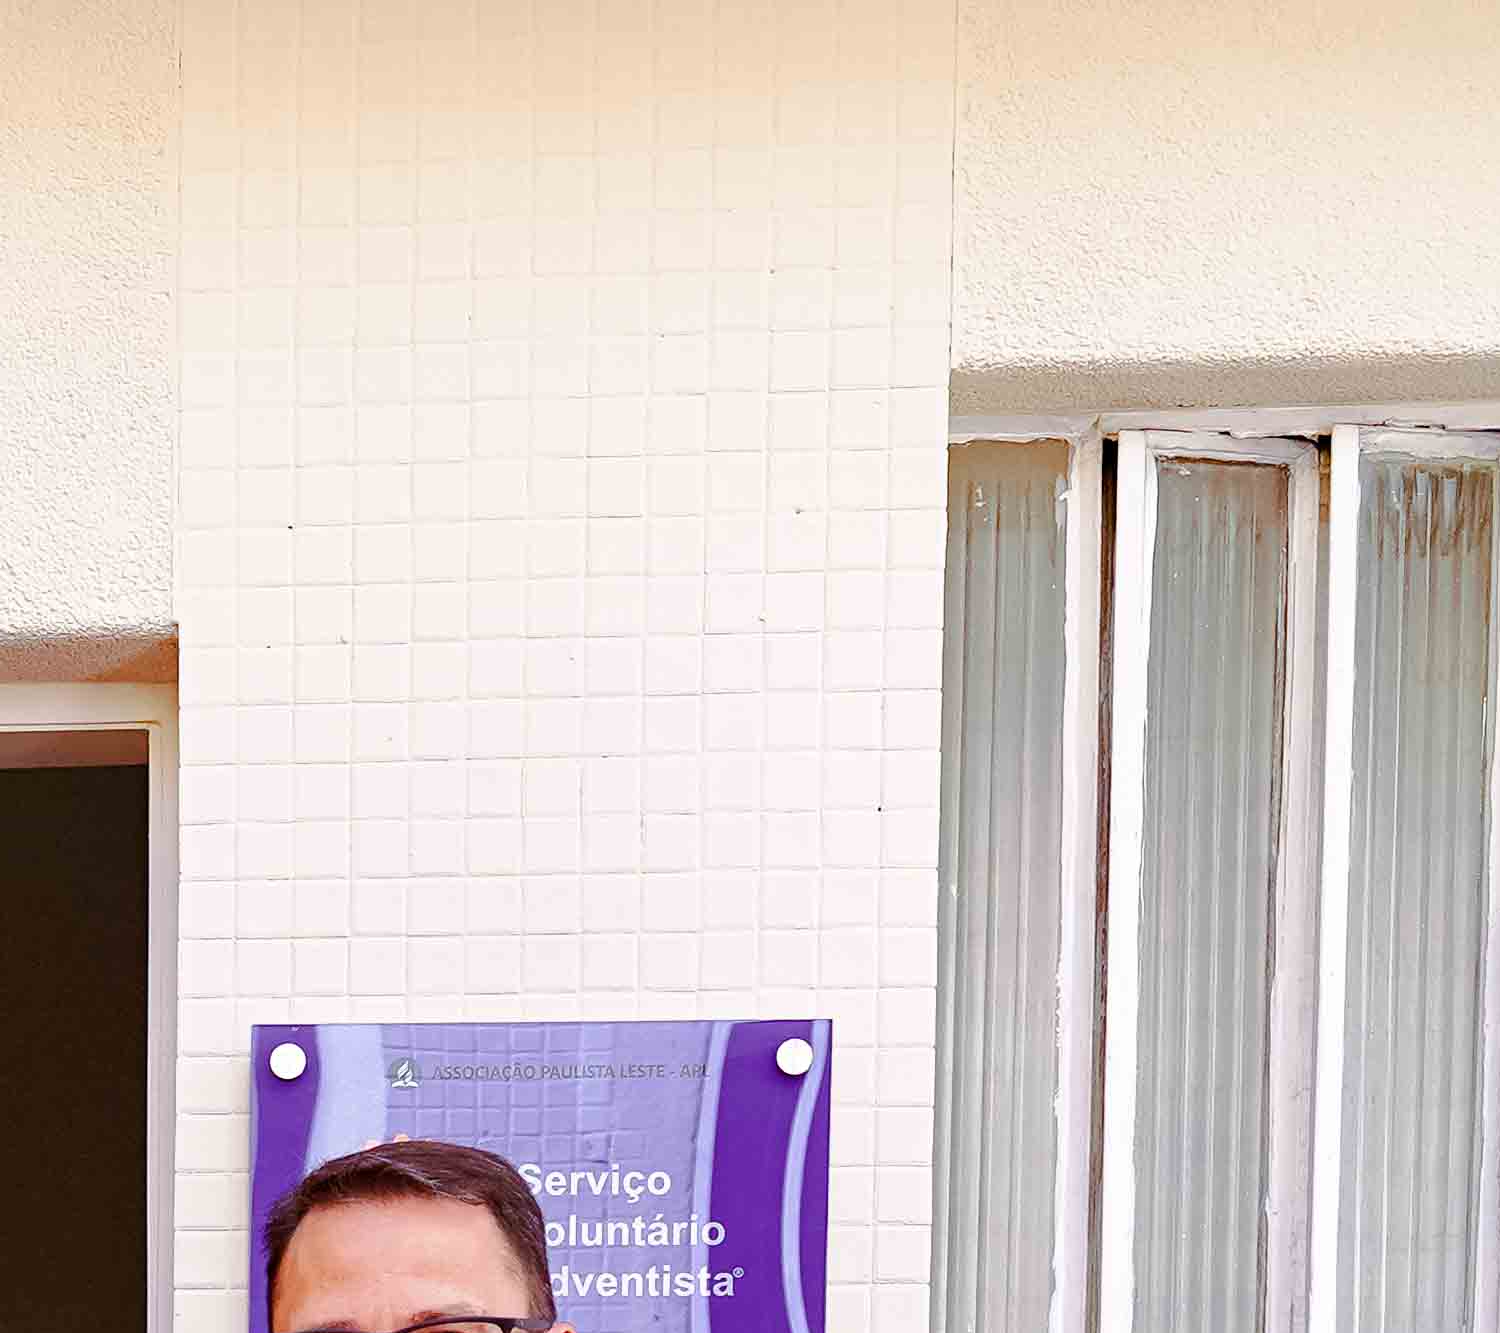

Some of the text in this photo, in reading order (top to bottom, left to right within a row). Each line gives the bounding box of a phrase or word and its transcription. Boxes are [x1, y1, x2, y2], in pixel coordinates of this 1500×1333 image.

[432, 1061, 536, 1082] ASSOCIAÇÃO
[540, 1064, 616, 1080] PAULISTA
[619, 1063, 665, 1079] LESTE
[679, 1063, 711, 1079] APL
[518, 1163, 672, 1203] Serviço
[545, 1213, 726, 1247] oluntário
